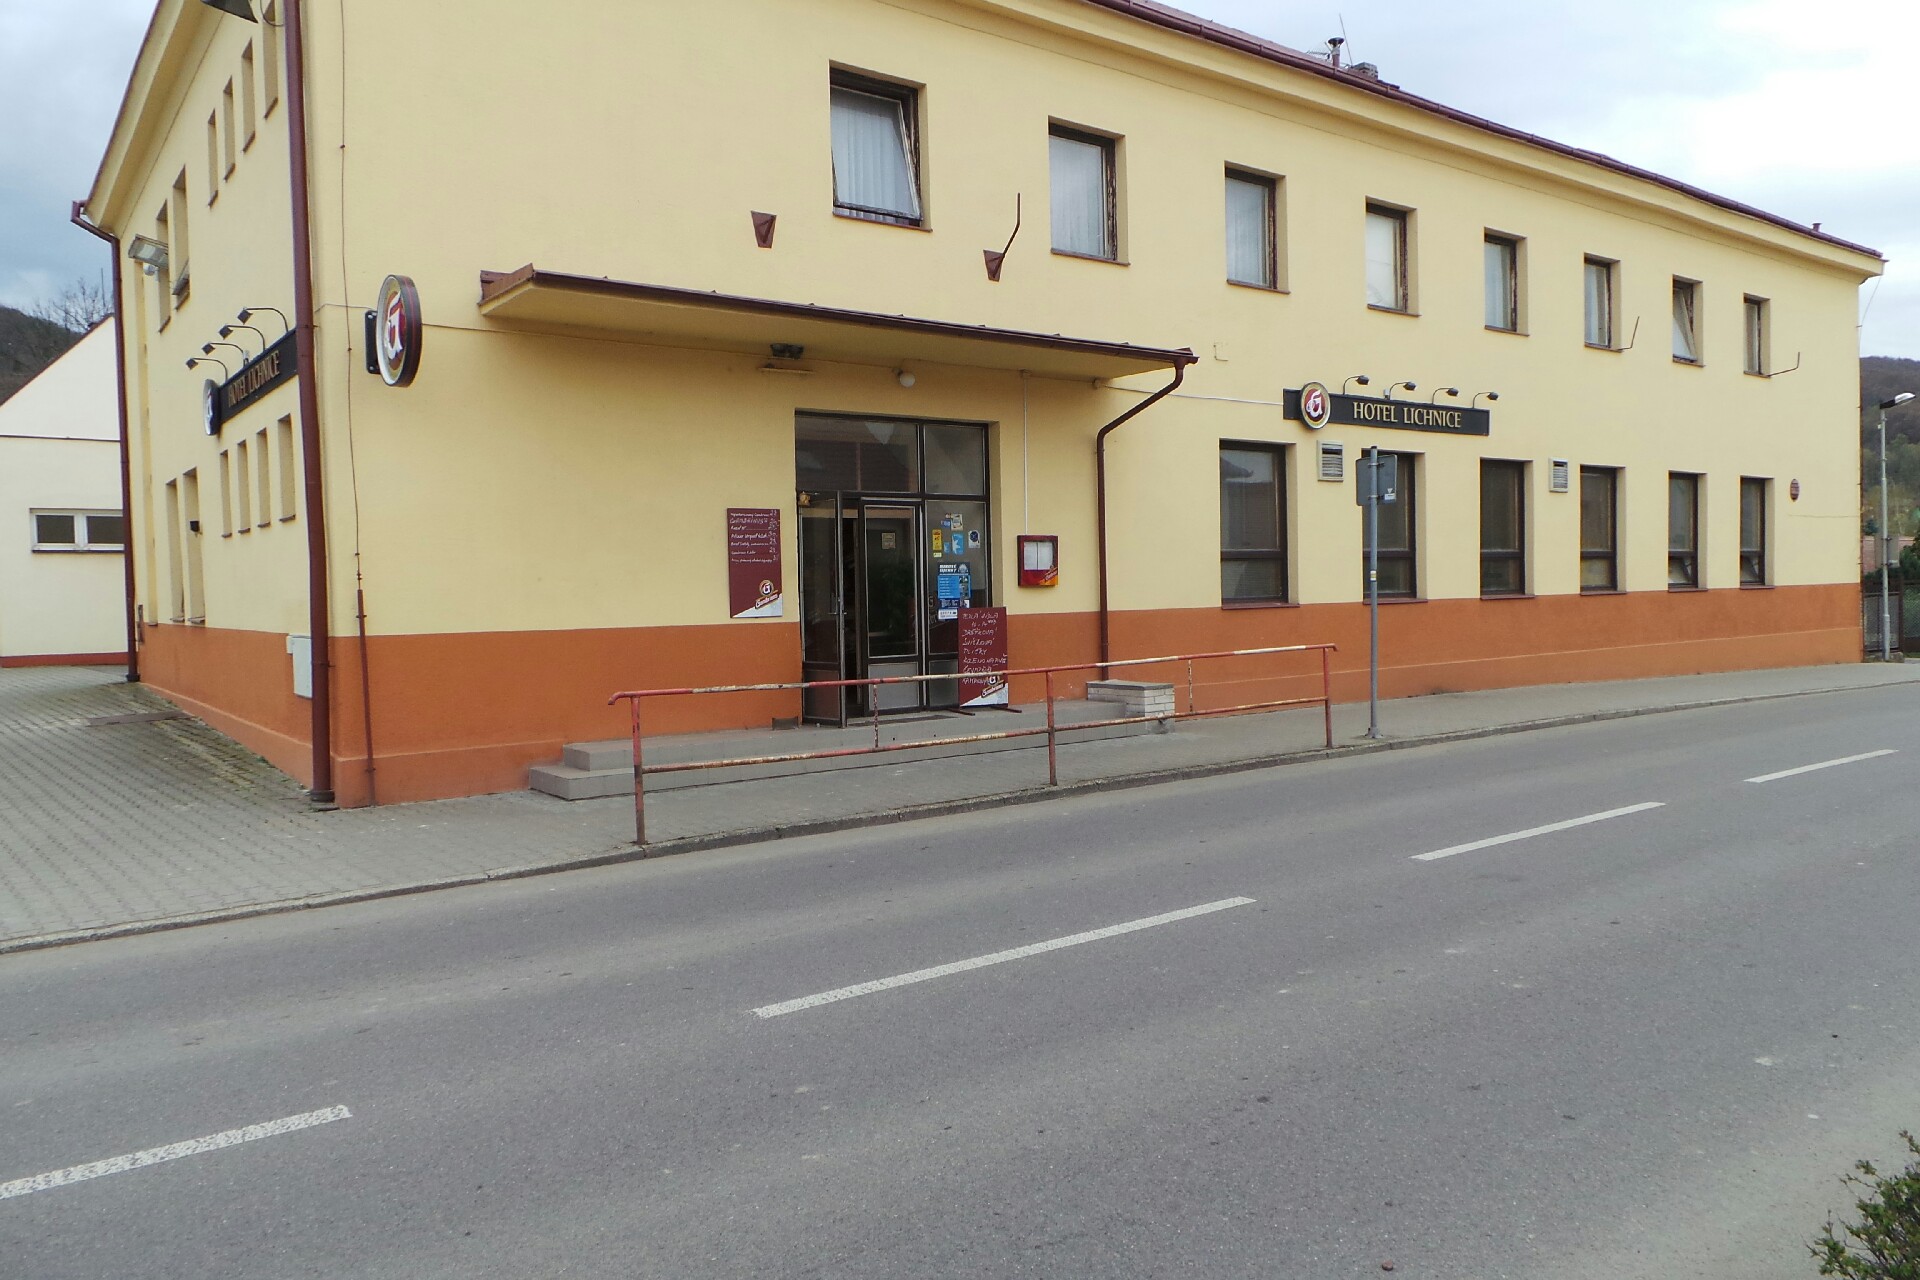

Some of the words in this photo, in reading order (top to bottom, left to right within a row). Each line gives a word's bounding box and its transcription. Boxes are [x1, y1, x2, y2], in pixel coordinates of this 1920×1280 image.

[229, 377, 247, 408] HOTEL
[248, 350, 280, 392] LICHNICE
[1353, 401, 1399, 423] HOTEL
[1403, 407, 1462, 428] LICHNICE
